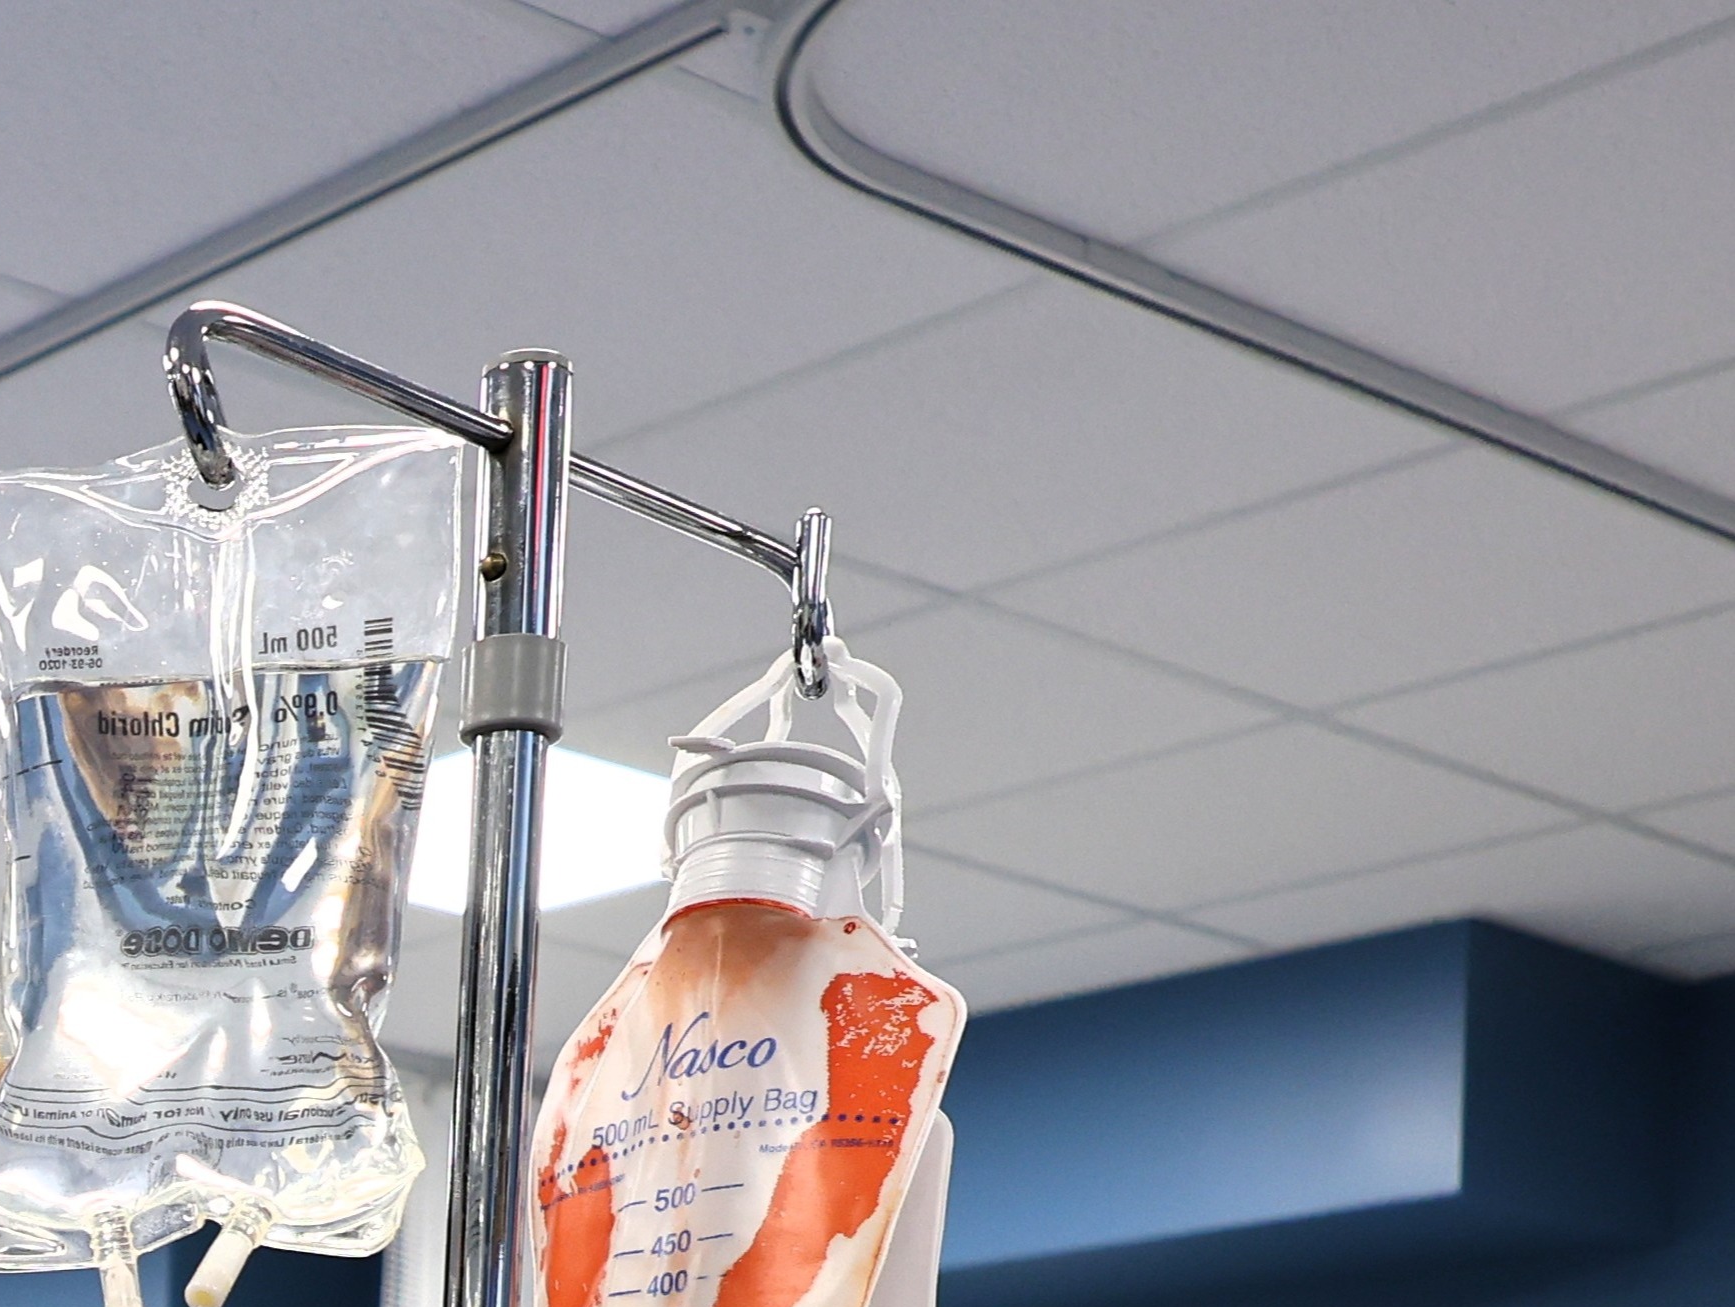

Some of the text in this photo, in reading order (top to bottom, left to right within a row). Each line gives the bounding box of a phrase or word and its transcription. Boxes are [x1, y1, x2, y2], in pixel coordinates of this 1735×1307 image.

[622, 1011, 777, 1101] Nasco
[592, 1088, 818, 1149] 500 mL Supply Bag
[655, 1182, 696, 1212] 500
[651, 1229, 692, 1258] 450
[646, 1269, 688, 1298] 400
